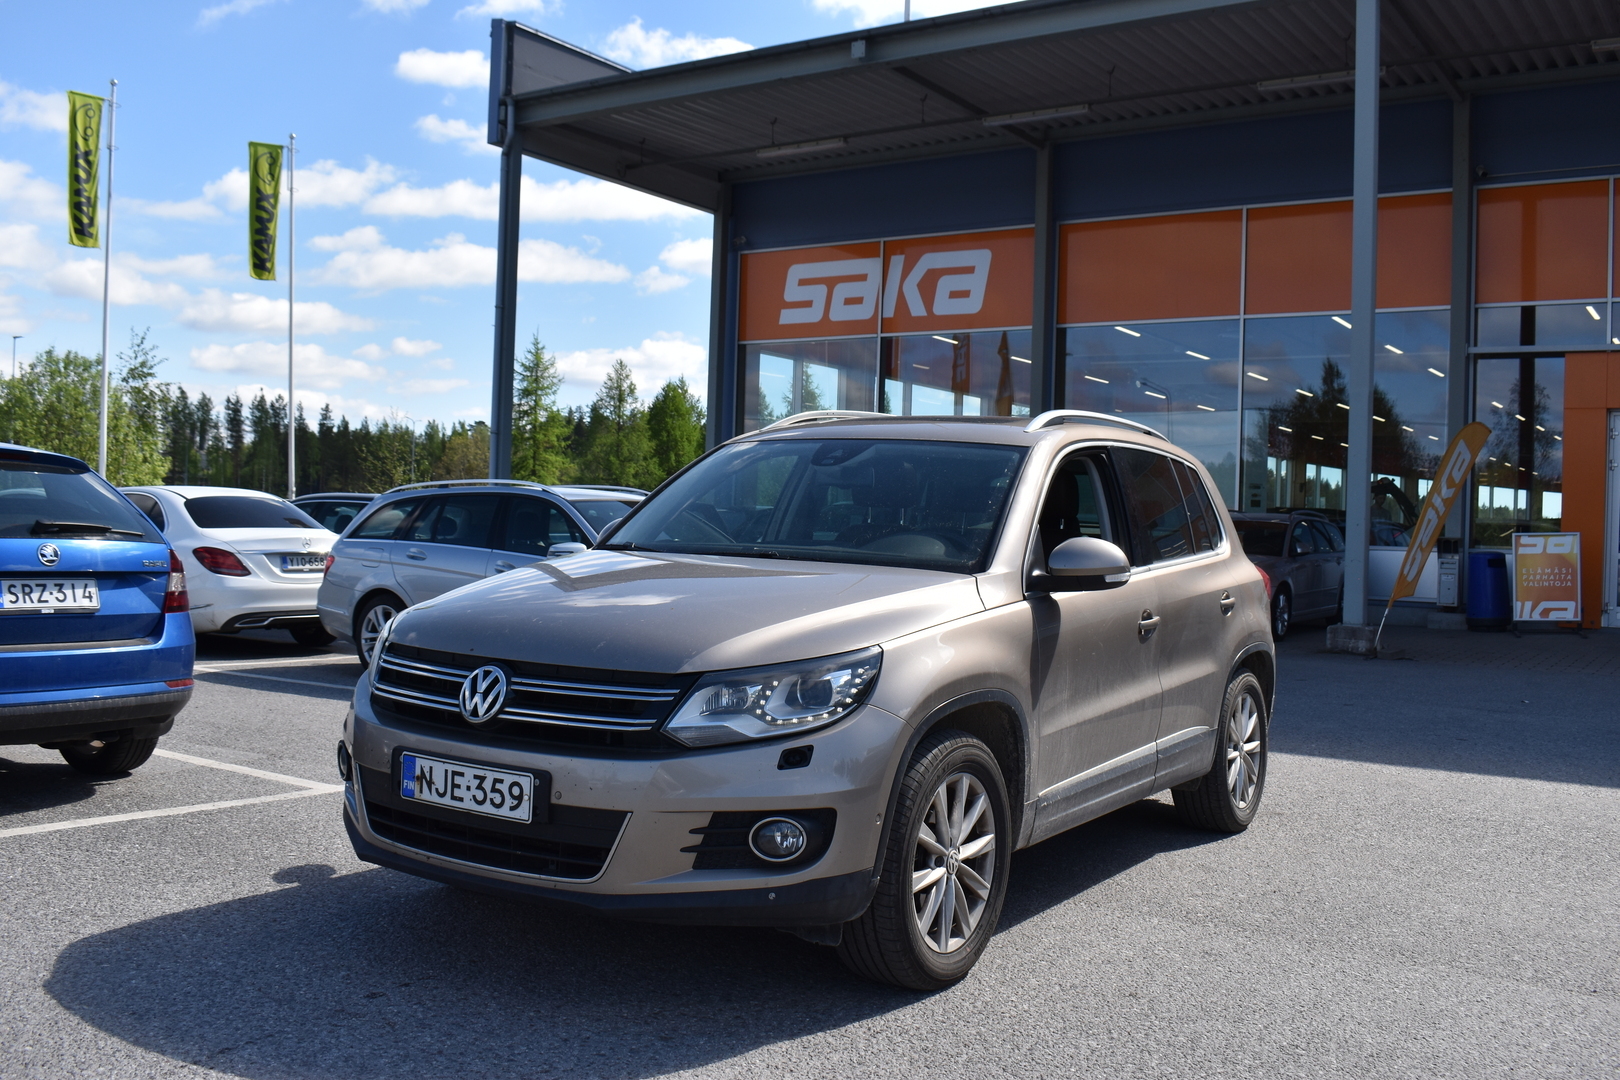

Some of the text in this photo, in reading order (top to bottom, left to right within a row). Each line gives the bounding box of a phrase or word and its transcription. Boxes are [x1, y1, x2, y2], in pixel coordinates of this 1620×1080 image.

[7, 583, 94, 604] SRZ-314
[403, 779, 415, 791] FIN
[419, 764, 524, 812] NJE-359
